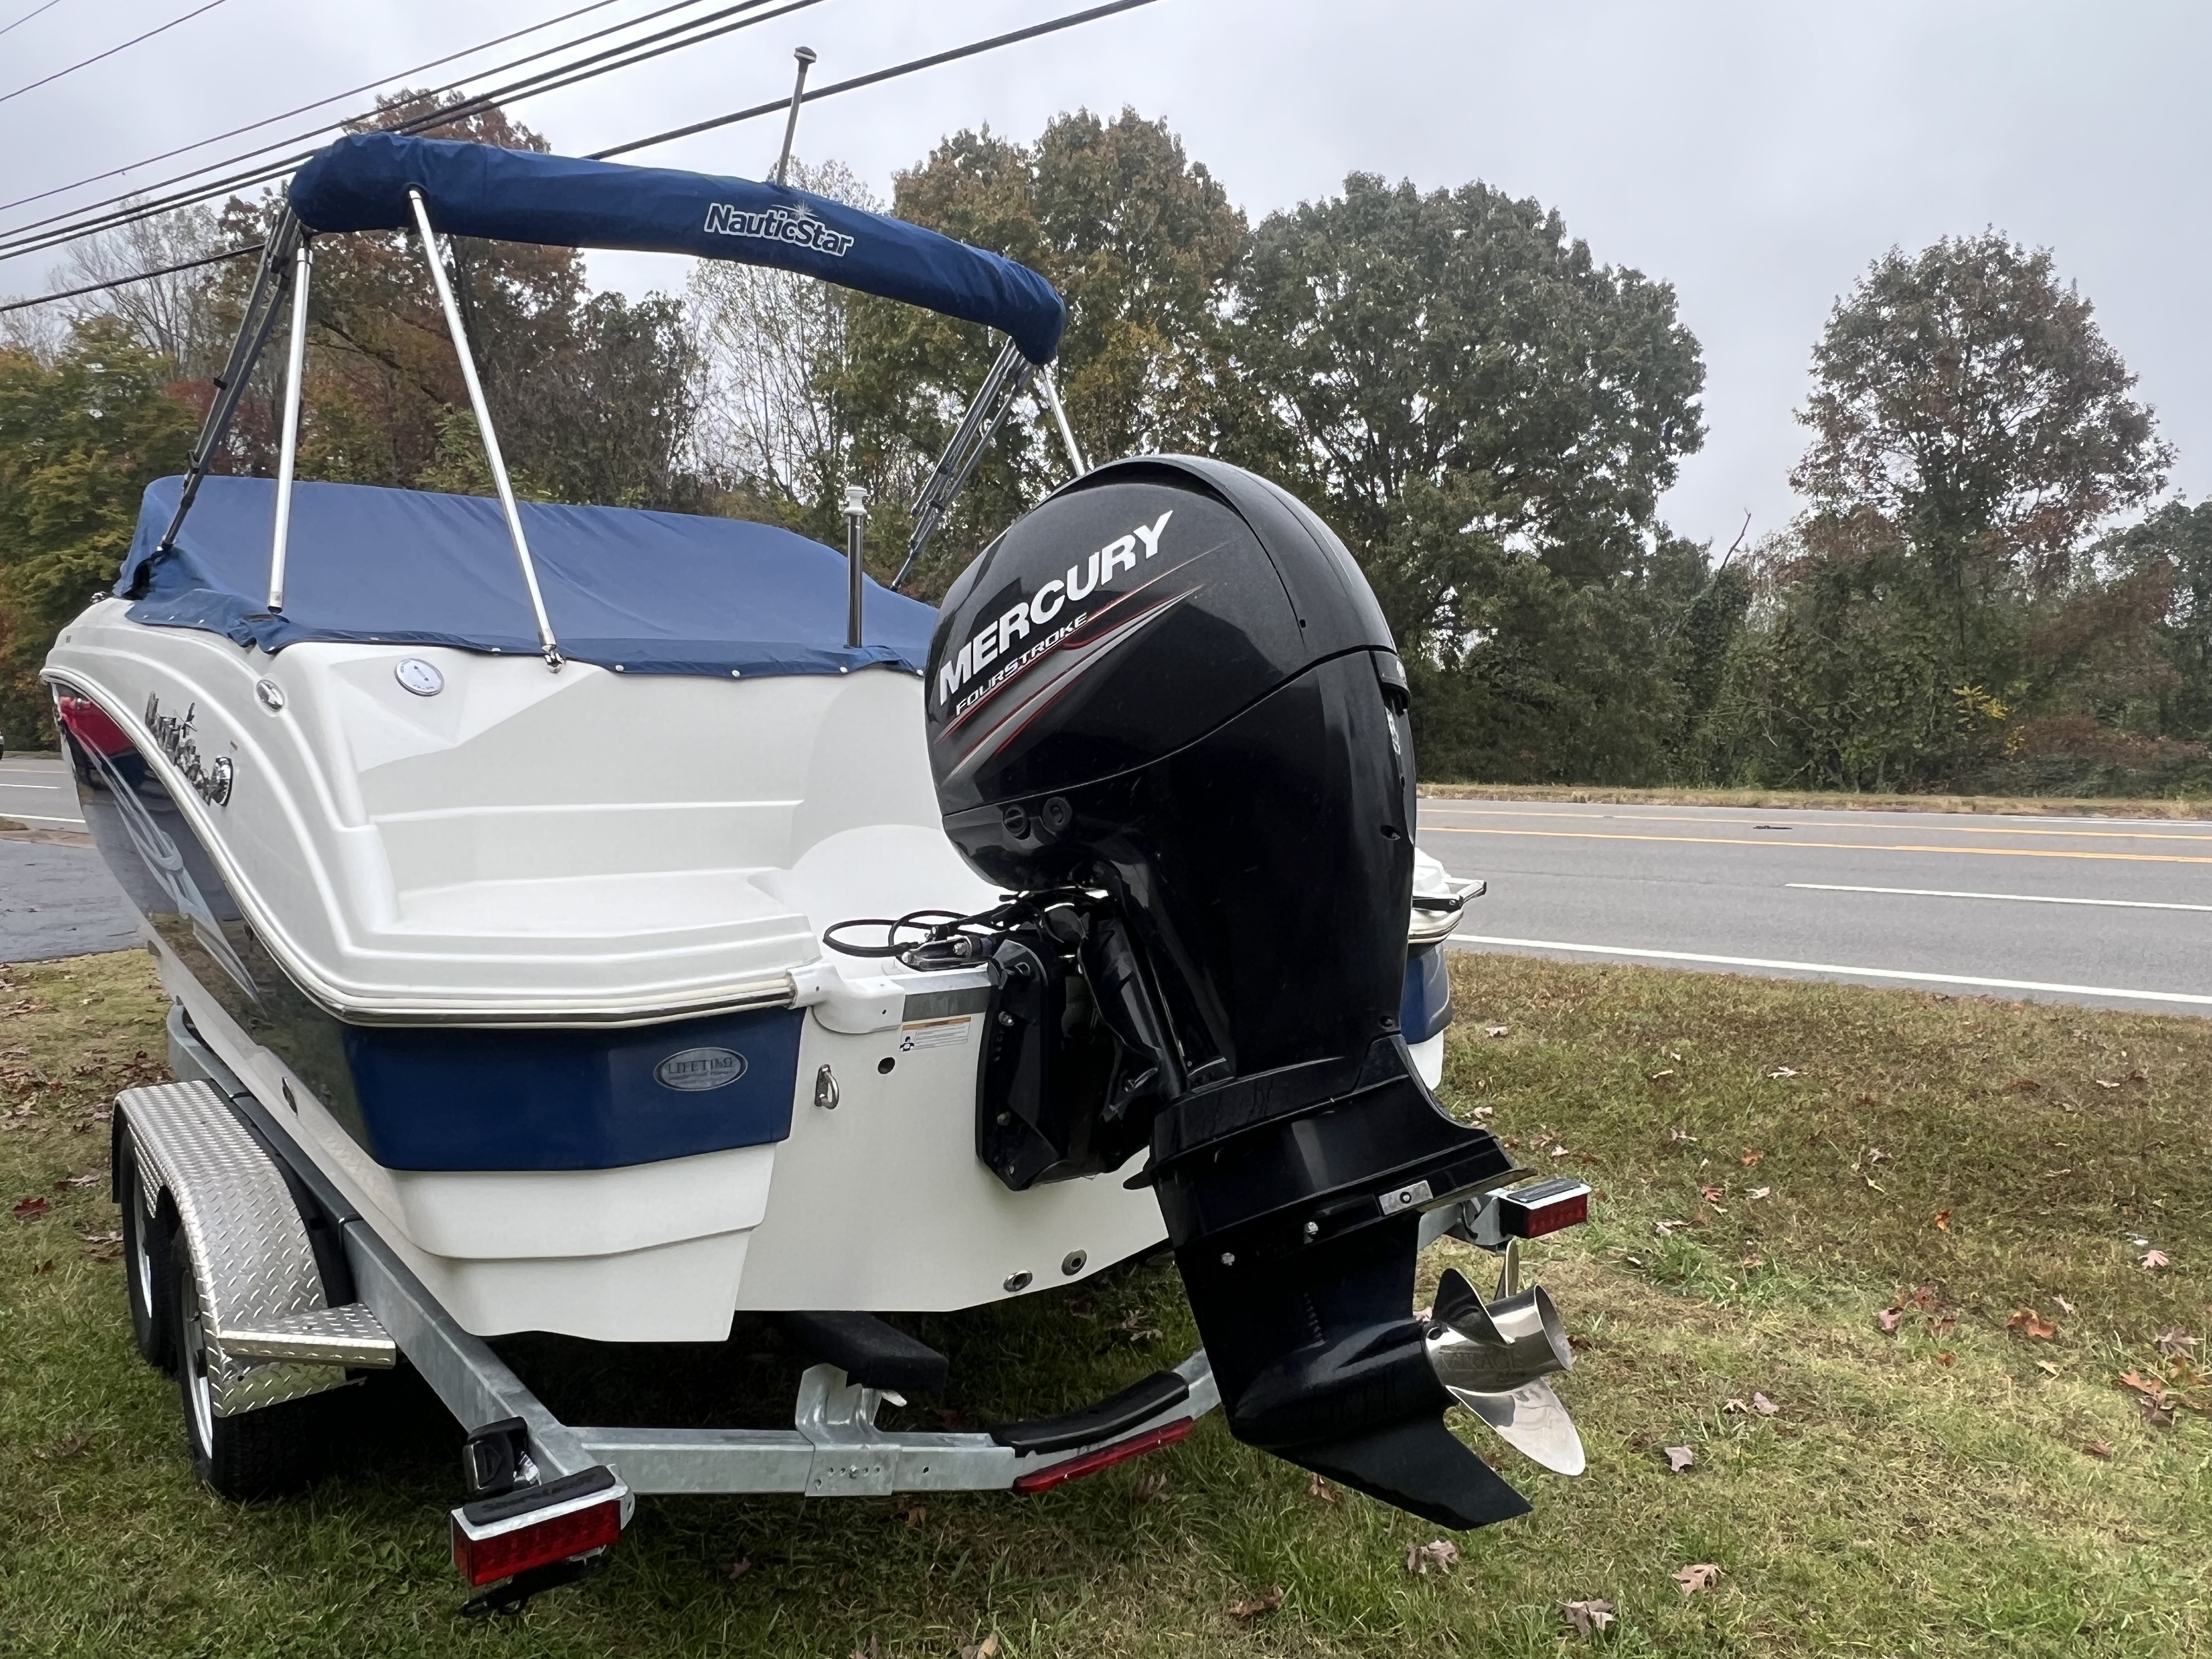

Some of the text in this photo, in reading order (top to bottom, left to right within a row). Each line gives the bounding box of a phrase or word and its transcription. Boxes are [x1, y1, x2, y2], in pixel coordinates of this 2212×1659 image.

[704, 202, 854, 257] NauticStar
[939, 509, 1173, 706] MERCURY
[956, 612, 1088, 716] FOURSTROKE
